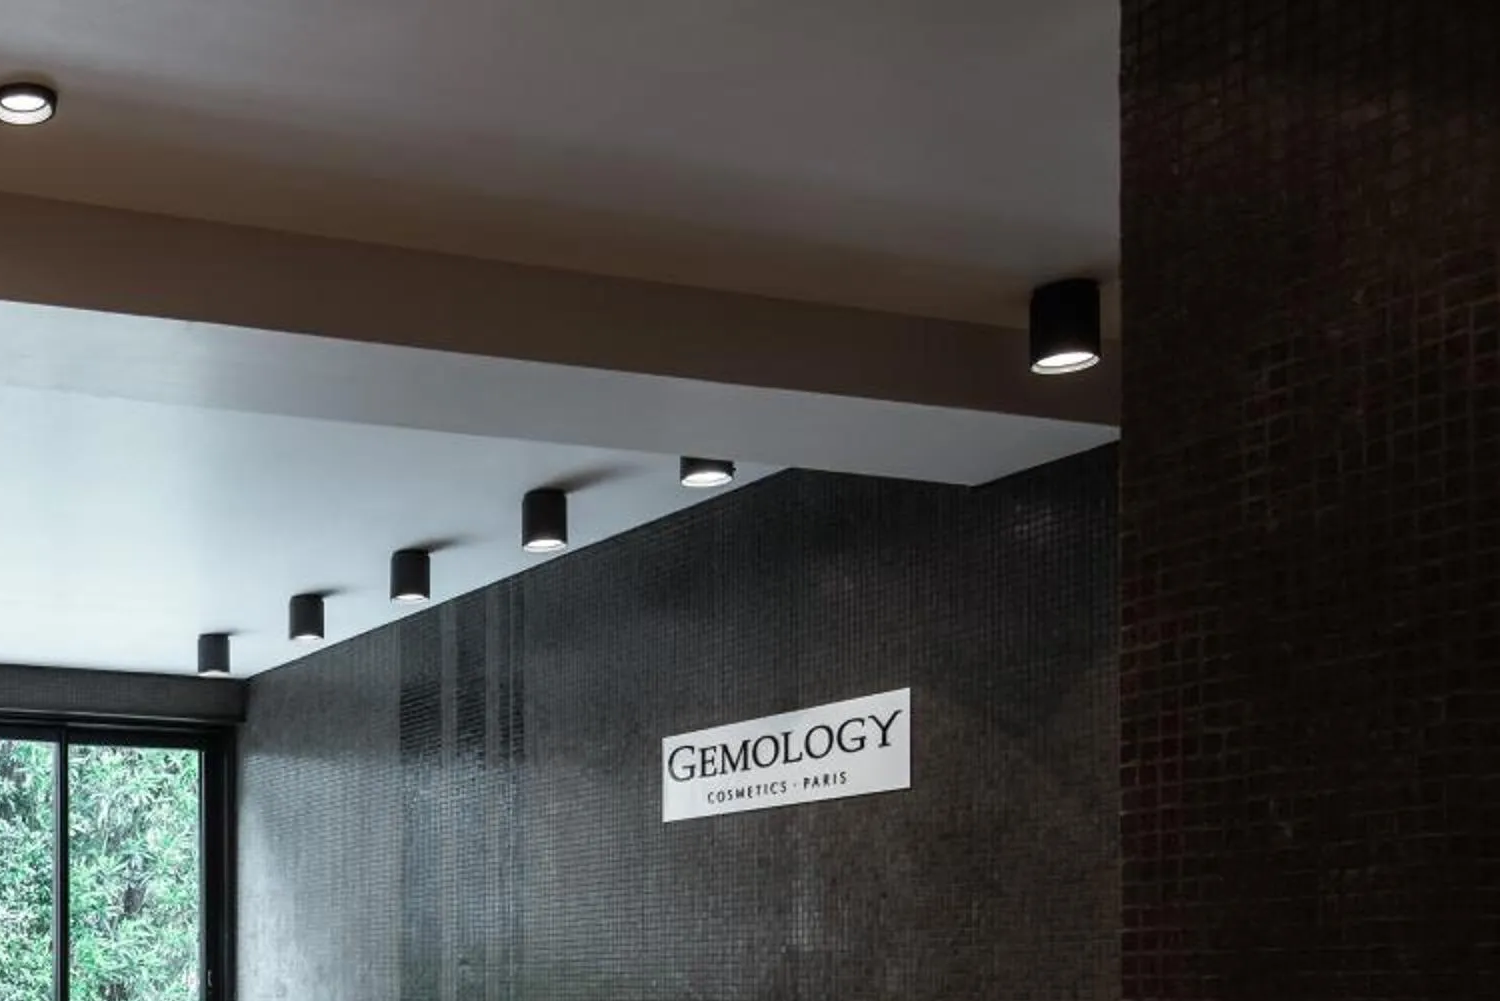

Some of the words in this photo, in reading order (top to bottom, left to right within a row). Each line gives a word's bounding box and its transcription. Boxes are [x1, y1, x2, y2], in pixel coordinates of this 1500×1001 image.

[667, 709, 904, 783] GEMOLOGY
[707, 781, 788, 805] COSMETICS
[803, 771, 848, 791] PARIS
